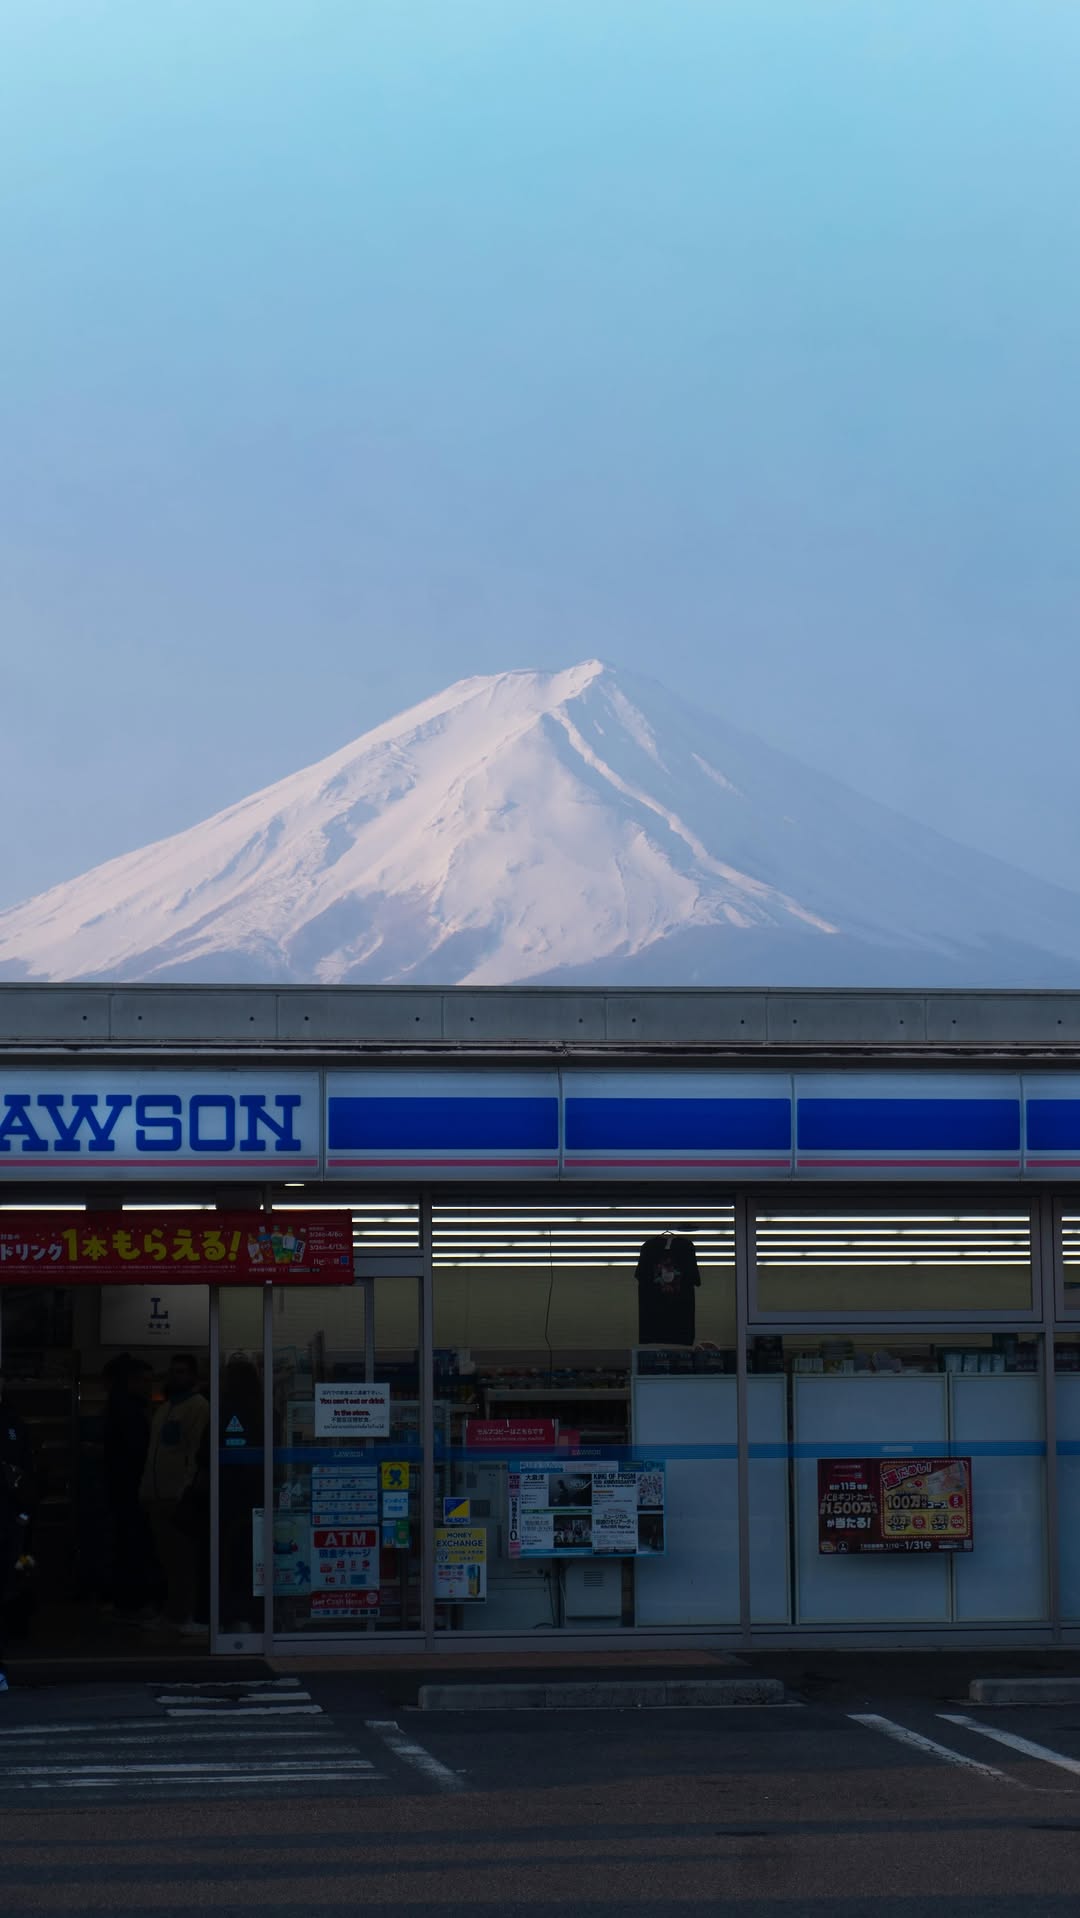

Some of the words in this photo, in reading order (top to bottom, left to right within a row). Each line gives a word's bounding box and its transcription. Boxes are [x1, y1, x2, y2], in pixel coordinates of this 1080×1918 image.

[0, 1095, 301, 1151] AWSON
[151, 1298, 168, 1319] L
[324, 1532, 366, 1546] ATM
